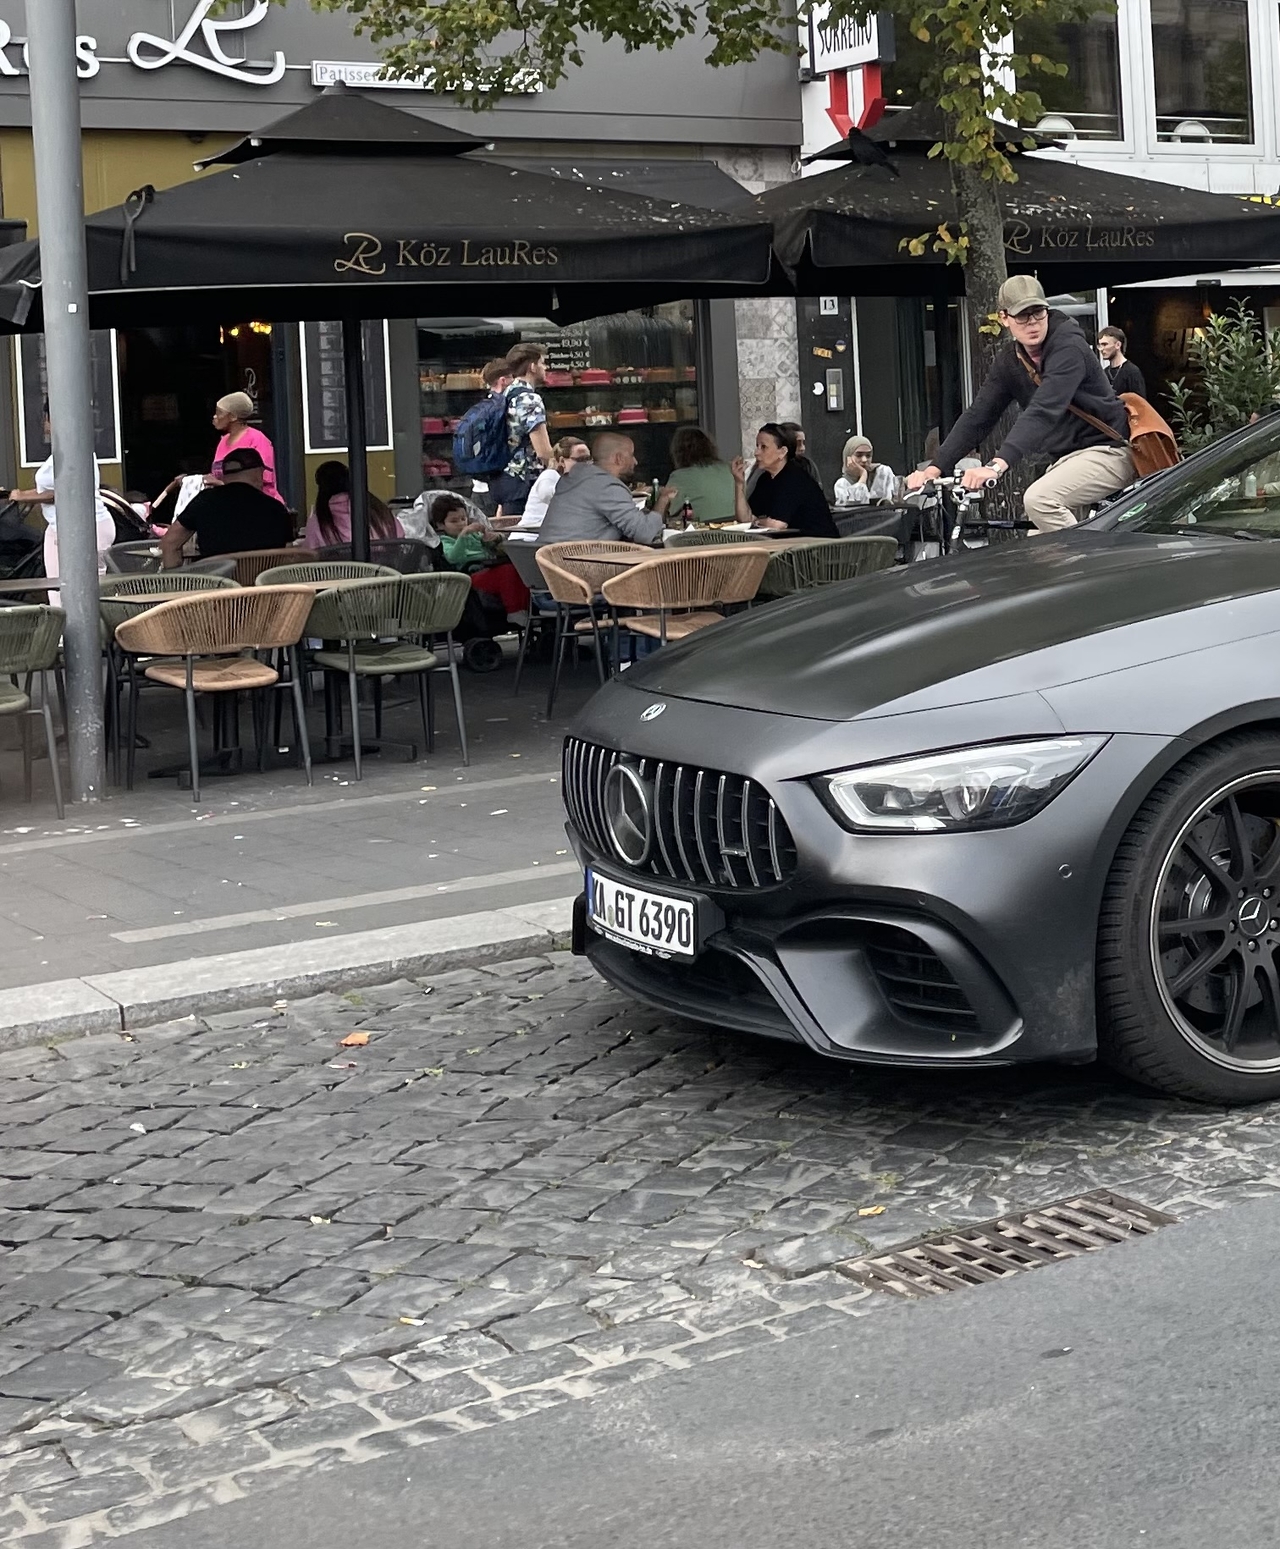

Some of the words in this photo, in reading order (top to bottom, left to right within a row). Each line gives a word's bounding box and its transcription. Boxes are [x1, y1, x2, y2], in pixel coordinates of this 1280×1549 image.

[1040, 225, 1078, 248] Köz
[1086, 225, 1155, 248] LauRes
[396, 239, 451, 266] Köz
[461, 239, 558, 266] LauRes
[823, 299, 836, 311] 13
[615, 889, 636, 933] GT
[639, 898, 692, 948] 6390
